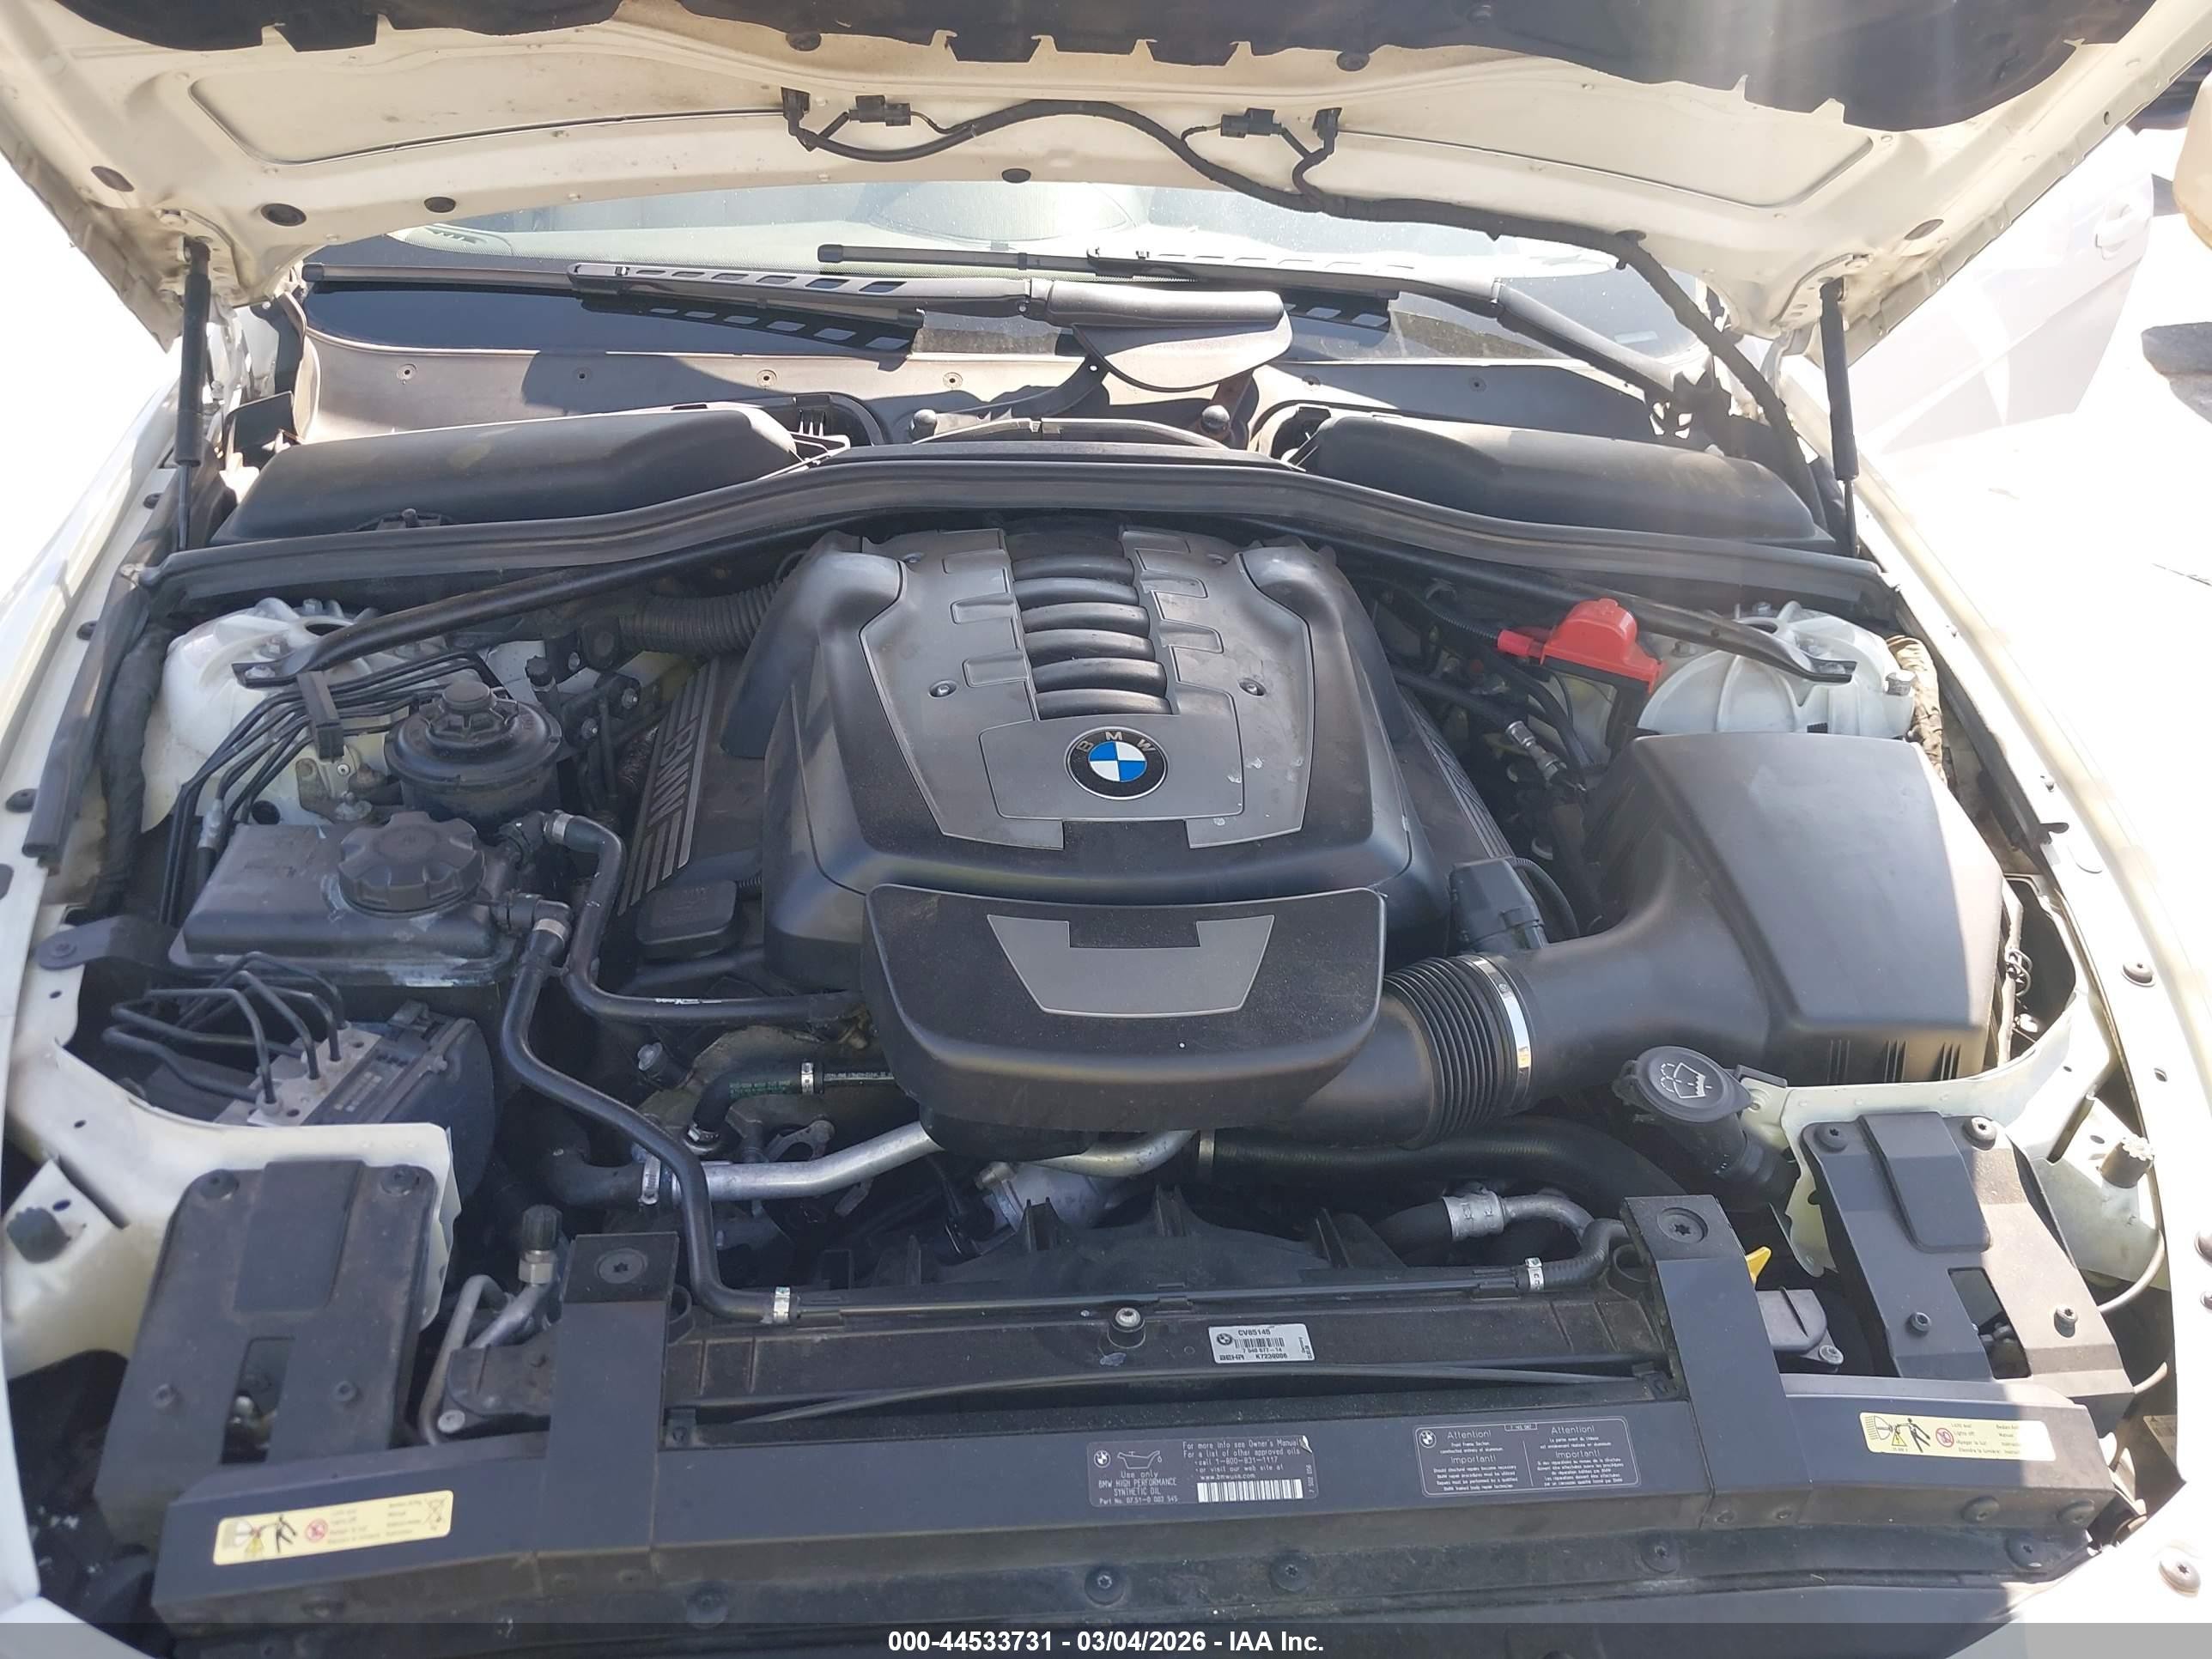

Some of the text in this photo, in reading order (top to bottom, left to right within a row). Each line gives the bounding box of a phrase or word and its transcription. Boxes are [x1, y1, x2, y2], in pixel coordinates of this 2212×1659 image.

[1076, 732, 1156, 752] BMW
[1447, 1430, 1491, 1439] Attention!
[1551, 1425, 1595, 1434] Attention!
[1182, 1441, 1194, 1450] For
[1217, 1439, 1231, 1449] info
[1183, 1449, 1194, 1458] For
[1222, 1448, 1229, 1456] of
[1255, 1447, 1284, 1457] approved
[1555, 1449, 1600, 1459] Important!
[1450, 1455, 1496, 1465] Important!
[1121, 1470, 1158, 1479] Use only
[1098, 1480, 1113, 1489] BMW
[1133, 1476, 1177, 1486] PERFORMANCE
[1114, 1486, 1162, 1497] SYNTHETIC OIL
